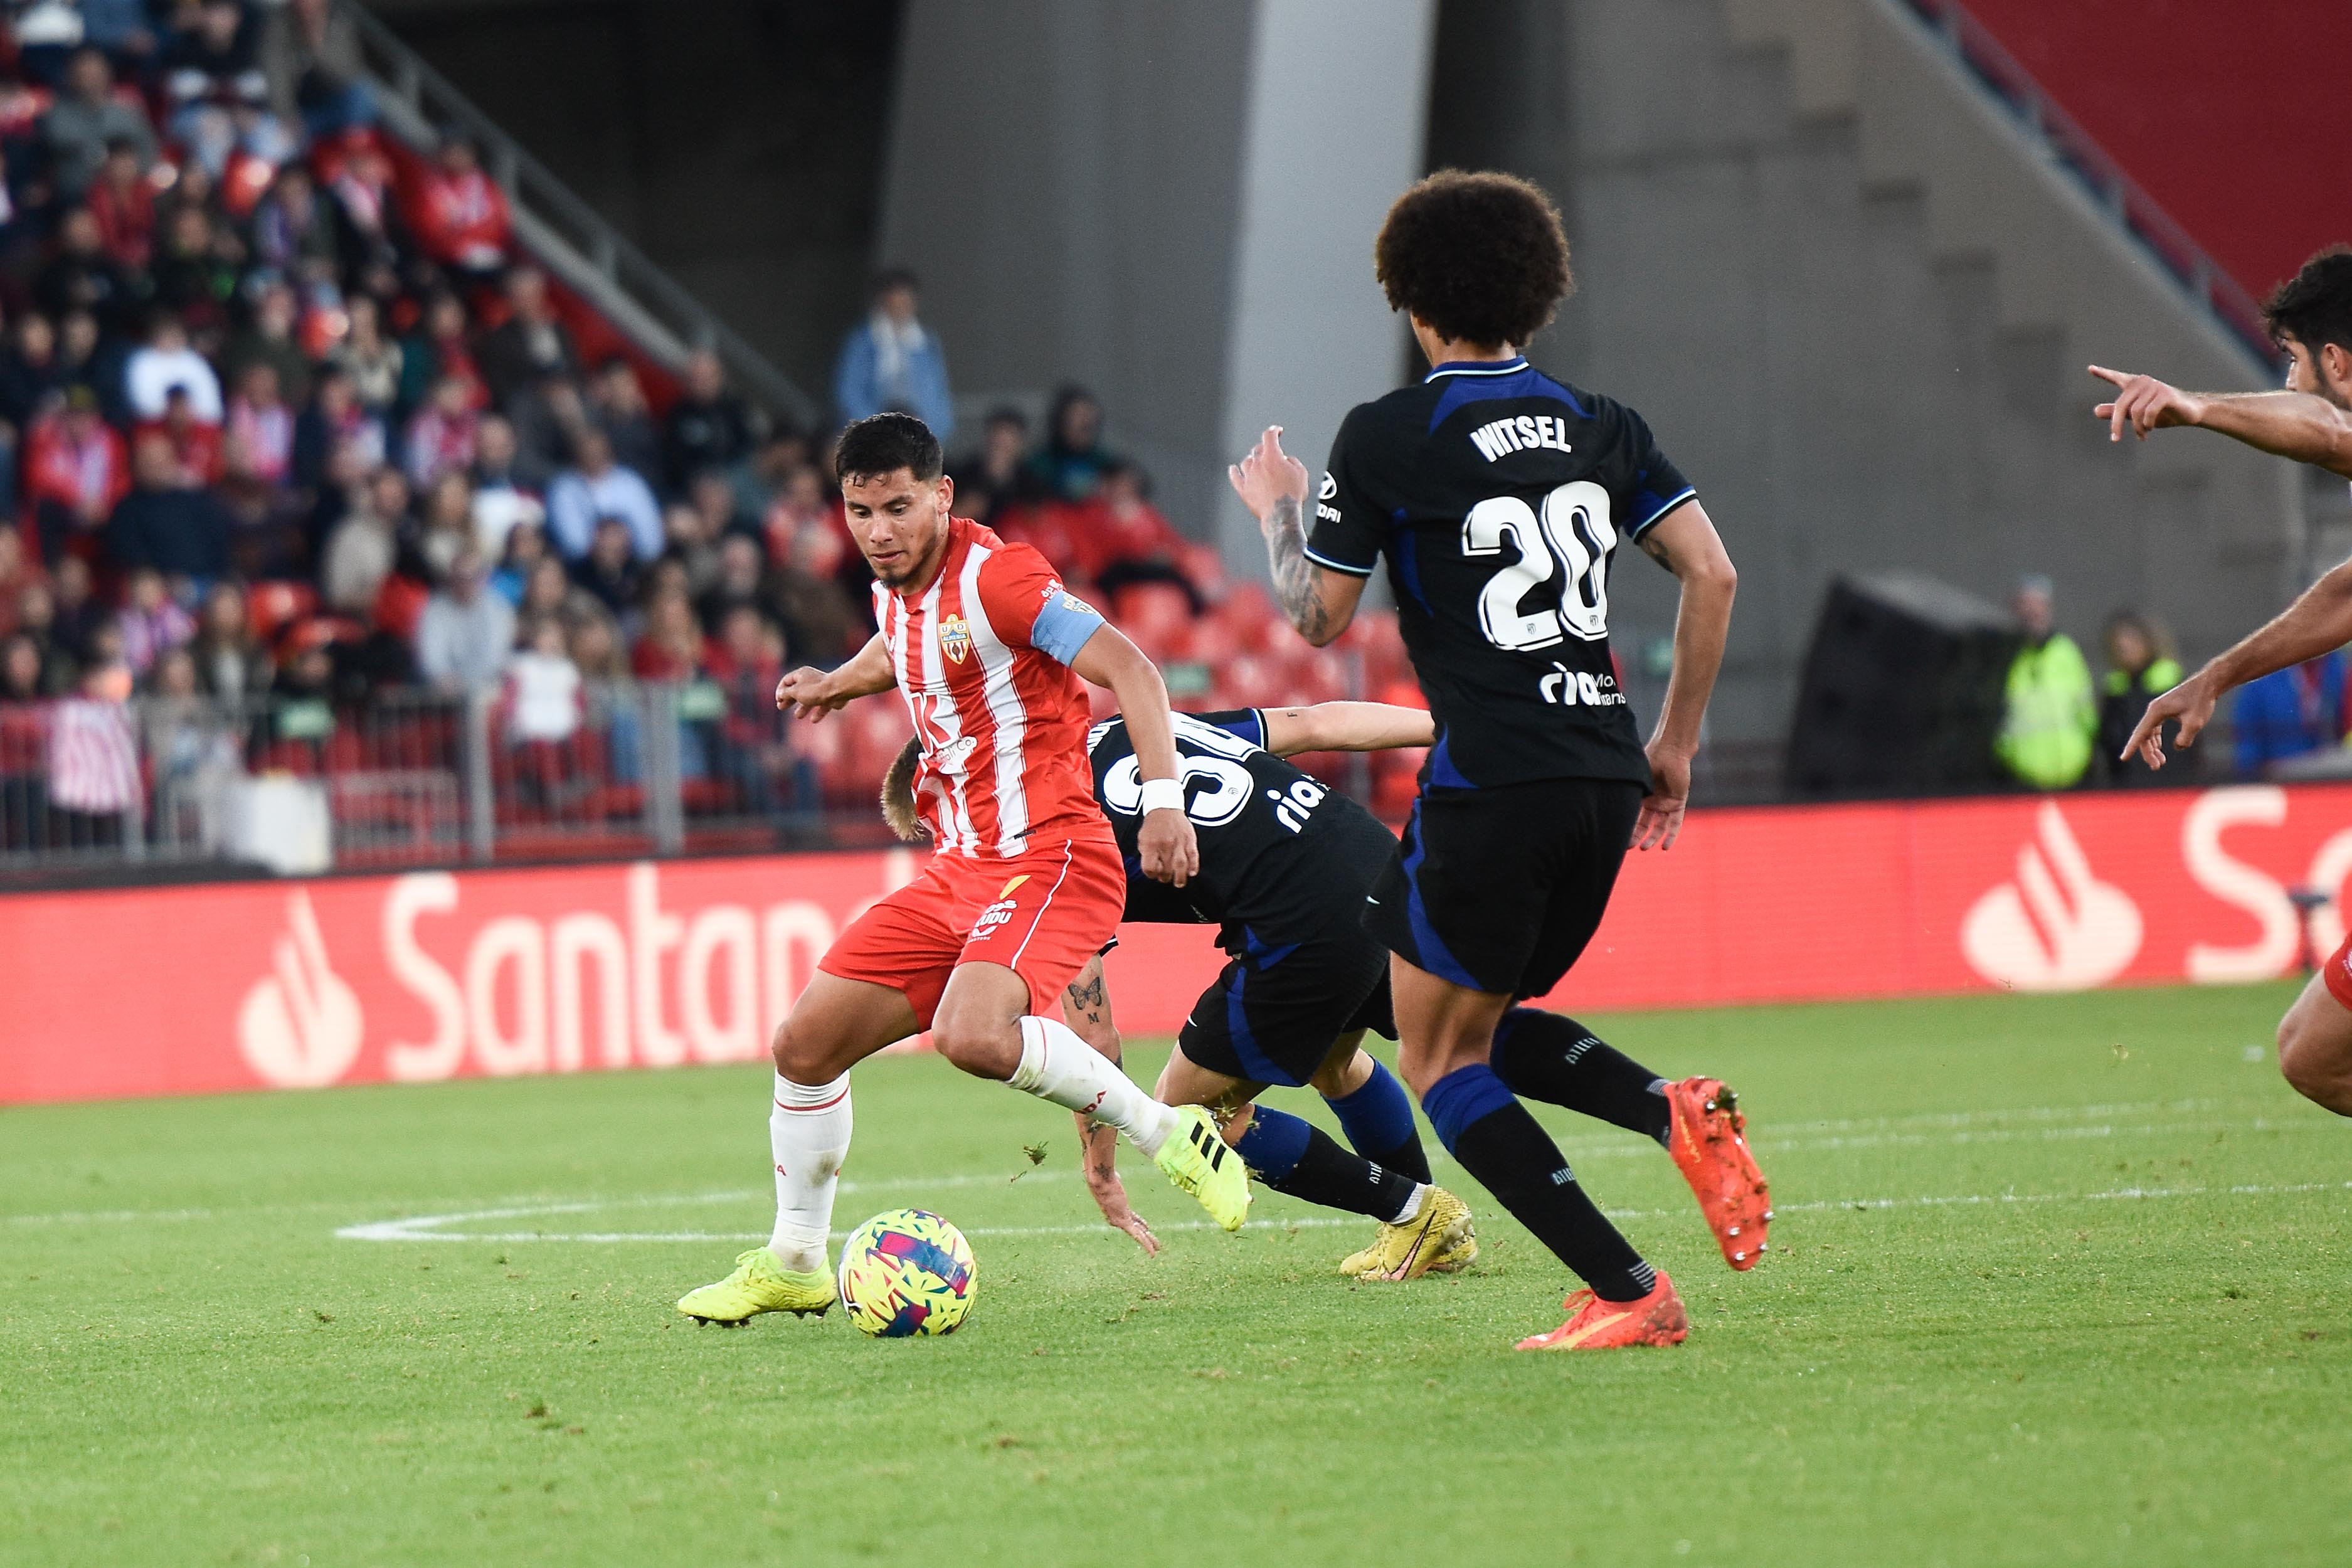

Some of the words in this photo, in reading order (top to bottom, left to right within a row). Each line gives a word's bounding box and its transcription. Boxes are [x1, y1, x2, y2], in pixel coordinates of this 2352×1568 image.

[1469, 415, 1572, 463] WITSEL
[1461, 480, 1618, 652] 20
[1267, 780, 1325, 834] ria
